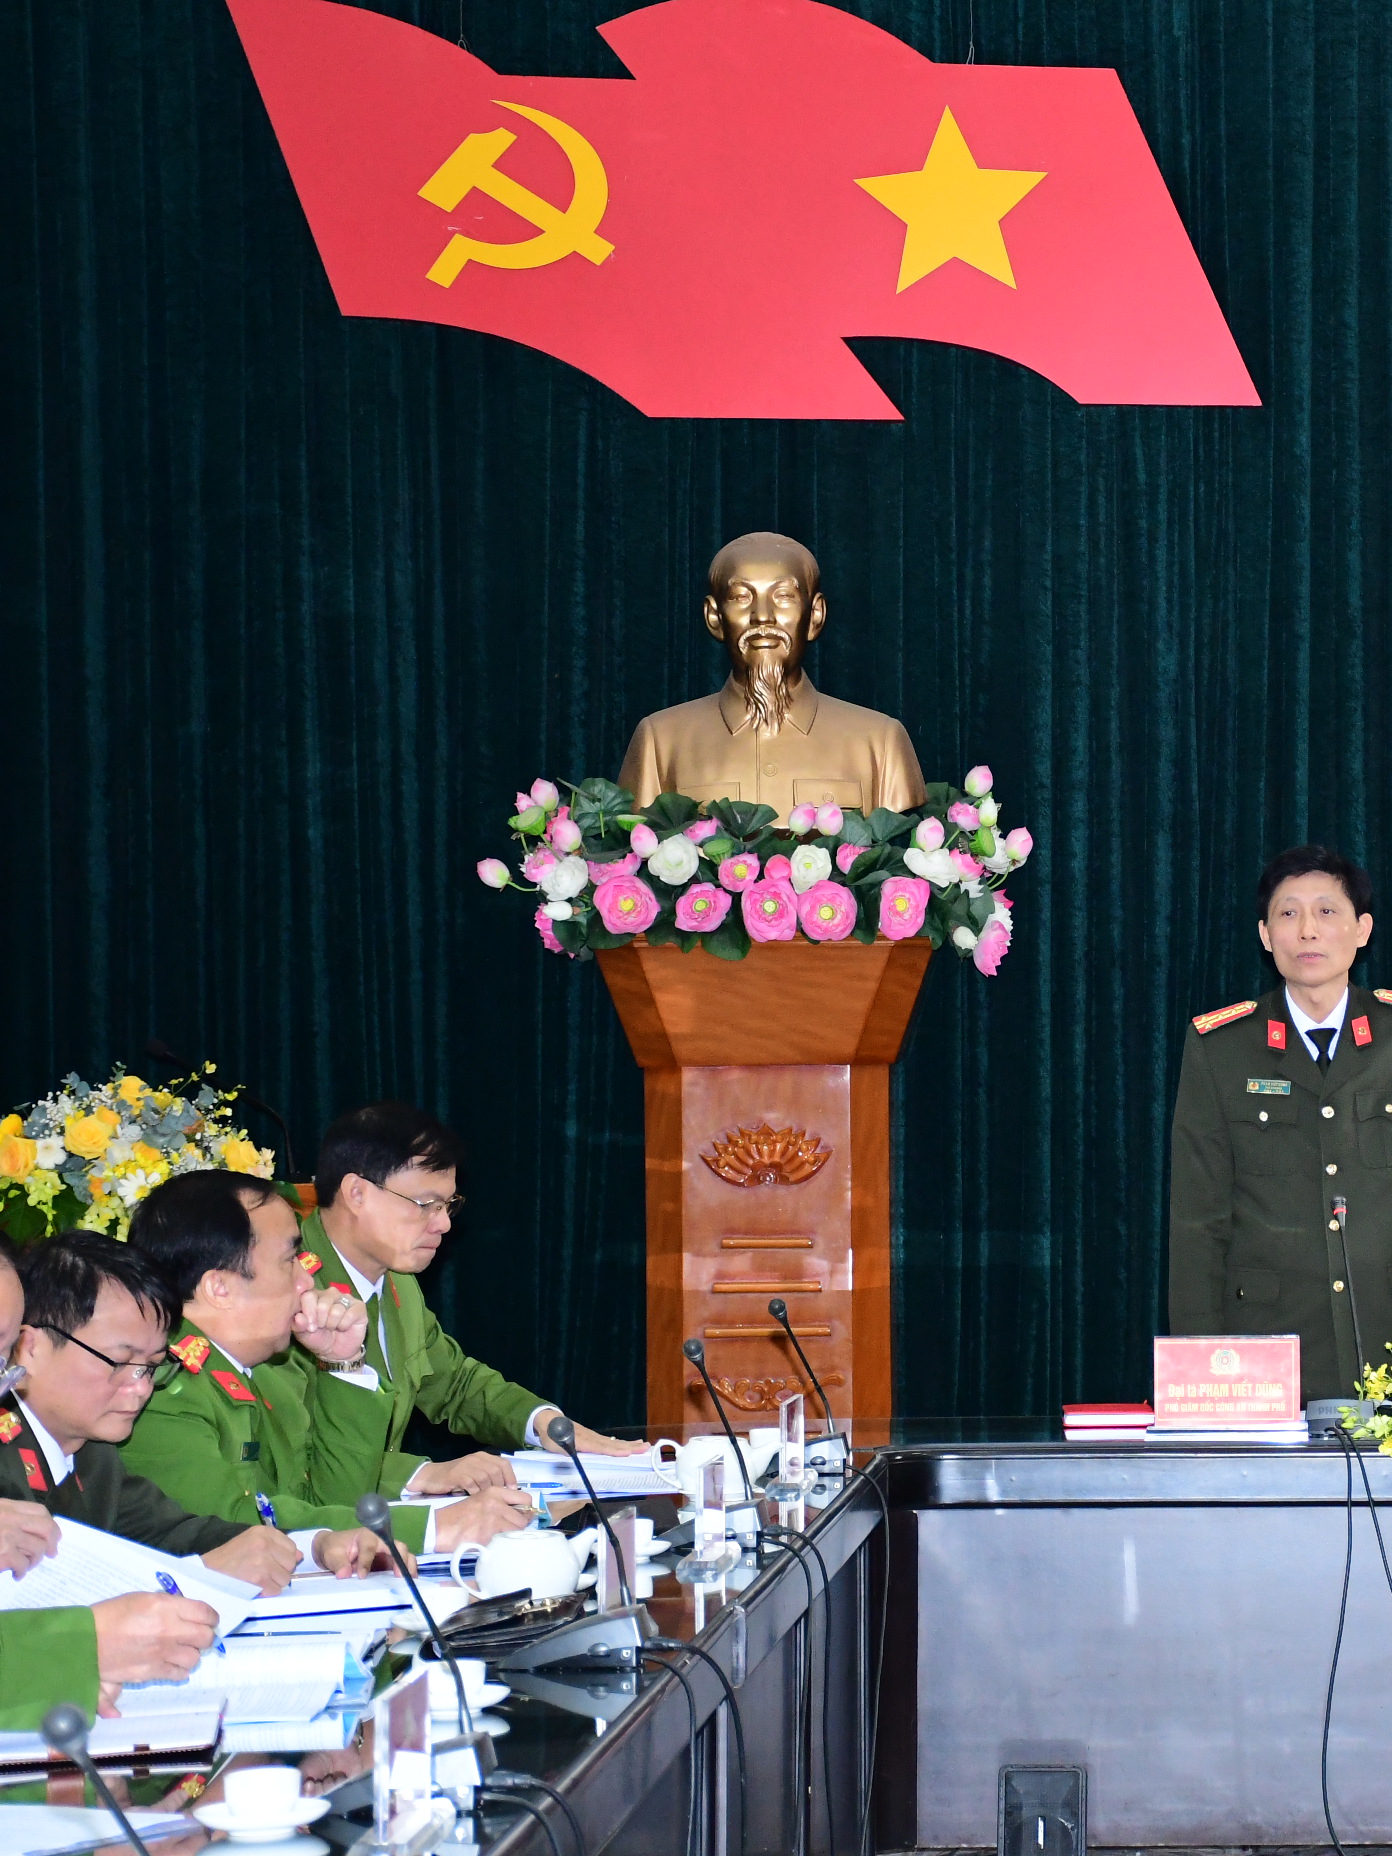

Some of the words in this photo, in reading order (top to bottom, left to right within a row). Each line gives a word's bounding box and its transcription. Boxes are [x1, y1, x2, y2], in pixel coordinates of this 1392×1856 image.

[1168, 1384, 1185, 1400] Đại
[1188, 1384, 1197, 1397] tá
[1200, 1384, 1229, 1400] PHẠM
[1232, 1379, 1253, 1397] VIẾT
[1256, 1381, 1283, 1397] DŨNG
